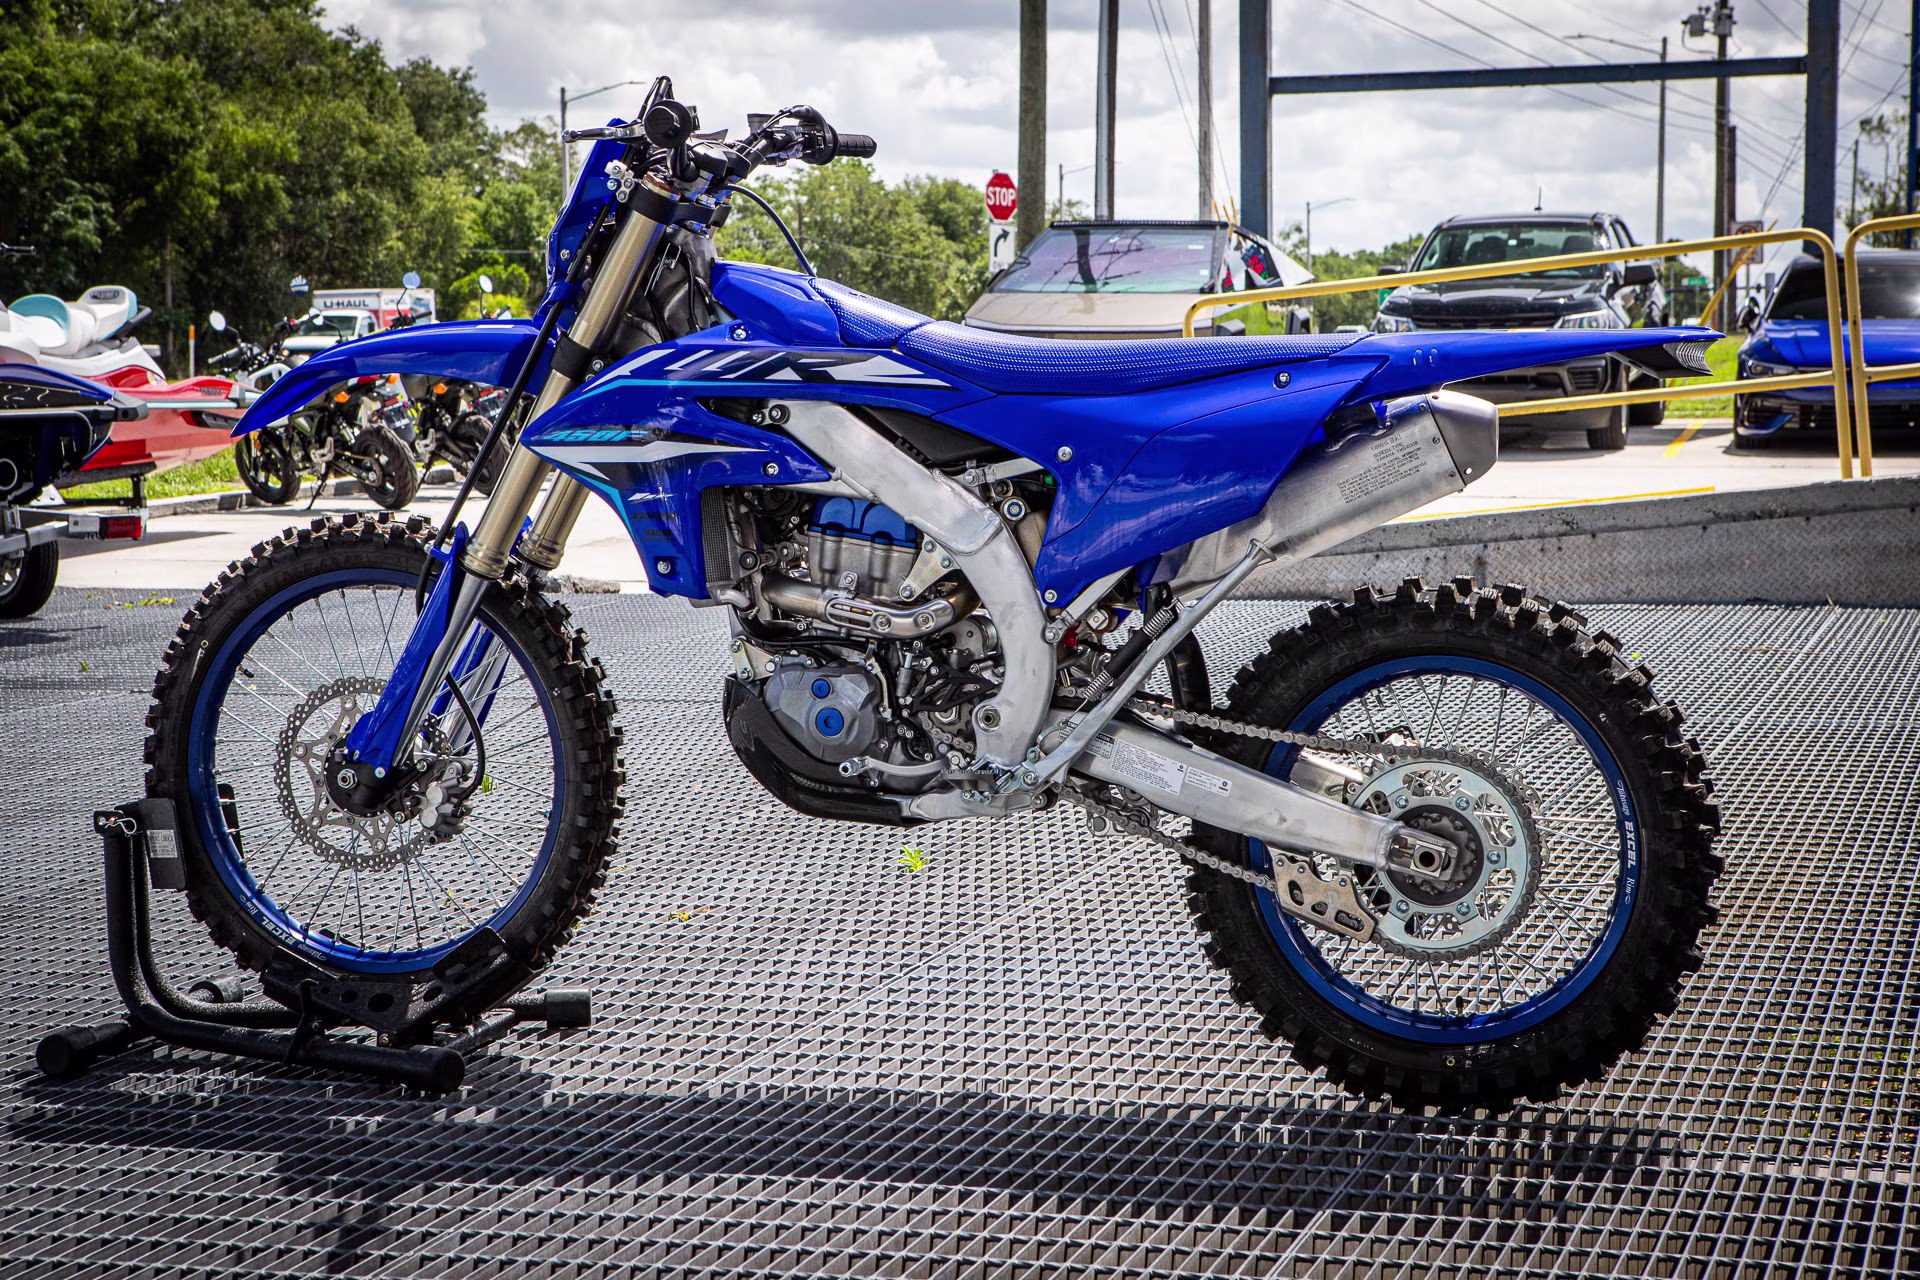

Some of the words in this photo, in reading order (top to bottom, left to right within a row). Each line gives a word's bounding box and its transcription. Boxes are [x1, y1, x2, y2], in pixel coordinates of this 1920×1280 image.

[987, 187, 1015, 206] STOP
[323, 300, 368, 308] U-HAUL
[1376, 452, 1395, 461] YAMAHA
[1624, 821, 1637, 869] EXCEL
[261, 916, 296, 945] EXCEL
